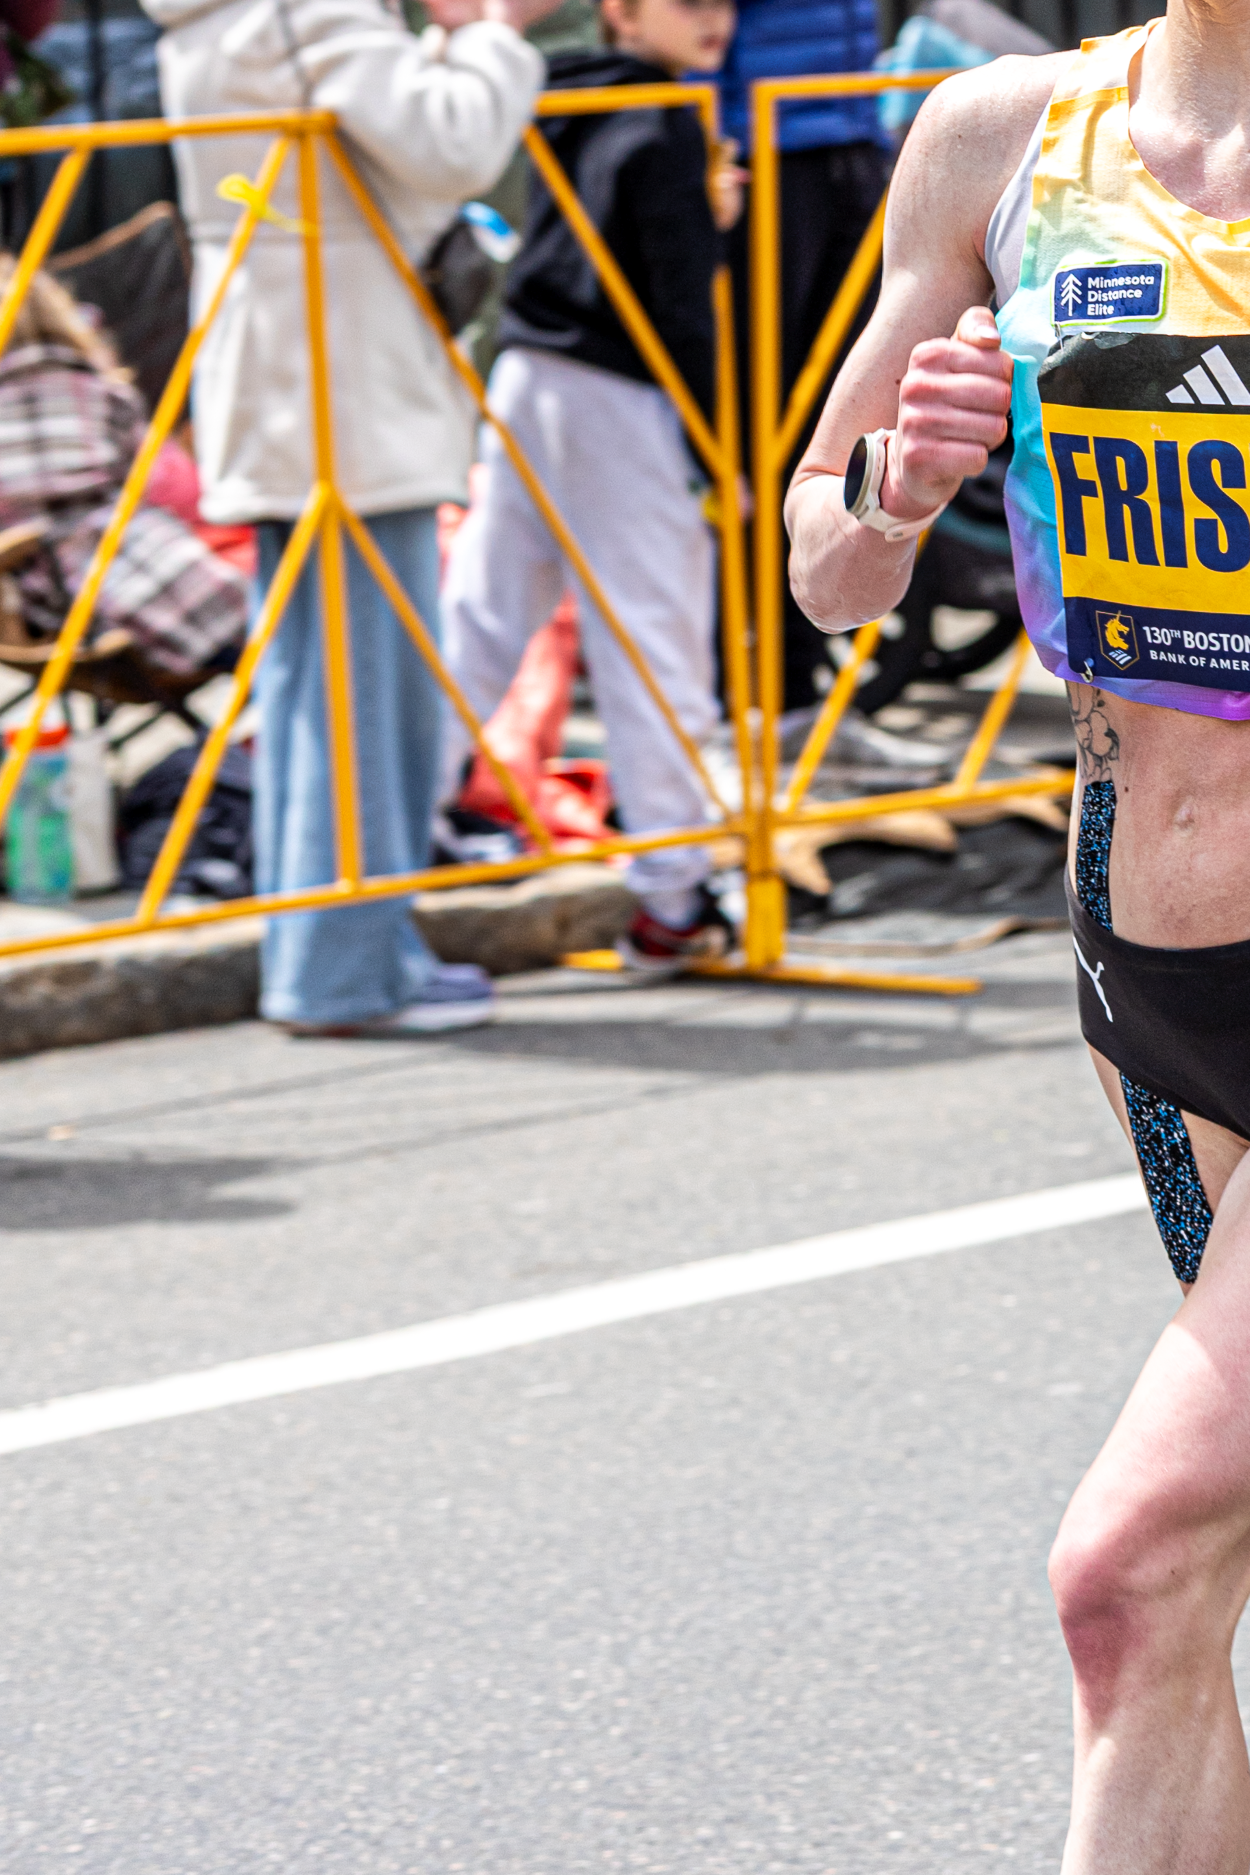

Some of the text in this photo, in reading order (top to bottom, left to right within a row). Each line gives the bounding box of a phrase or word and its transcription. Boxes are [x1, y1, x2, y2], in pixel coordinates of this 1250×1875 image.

[1087, 275, 1155, 289] Minnesota
[1087, 288, 1143, 302] Distance
[1087, 303, 1115, 316] Elite
[1149, 649, 1187, 665] BANK
[1189, 655, 1207, 668] OF
